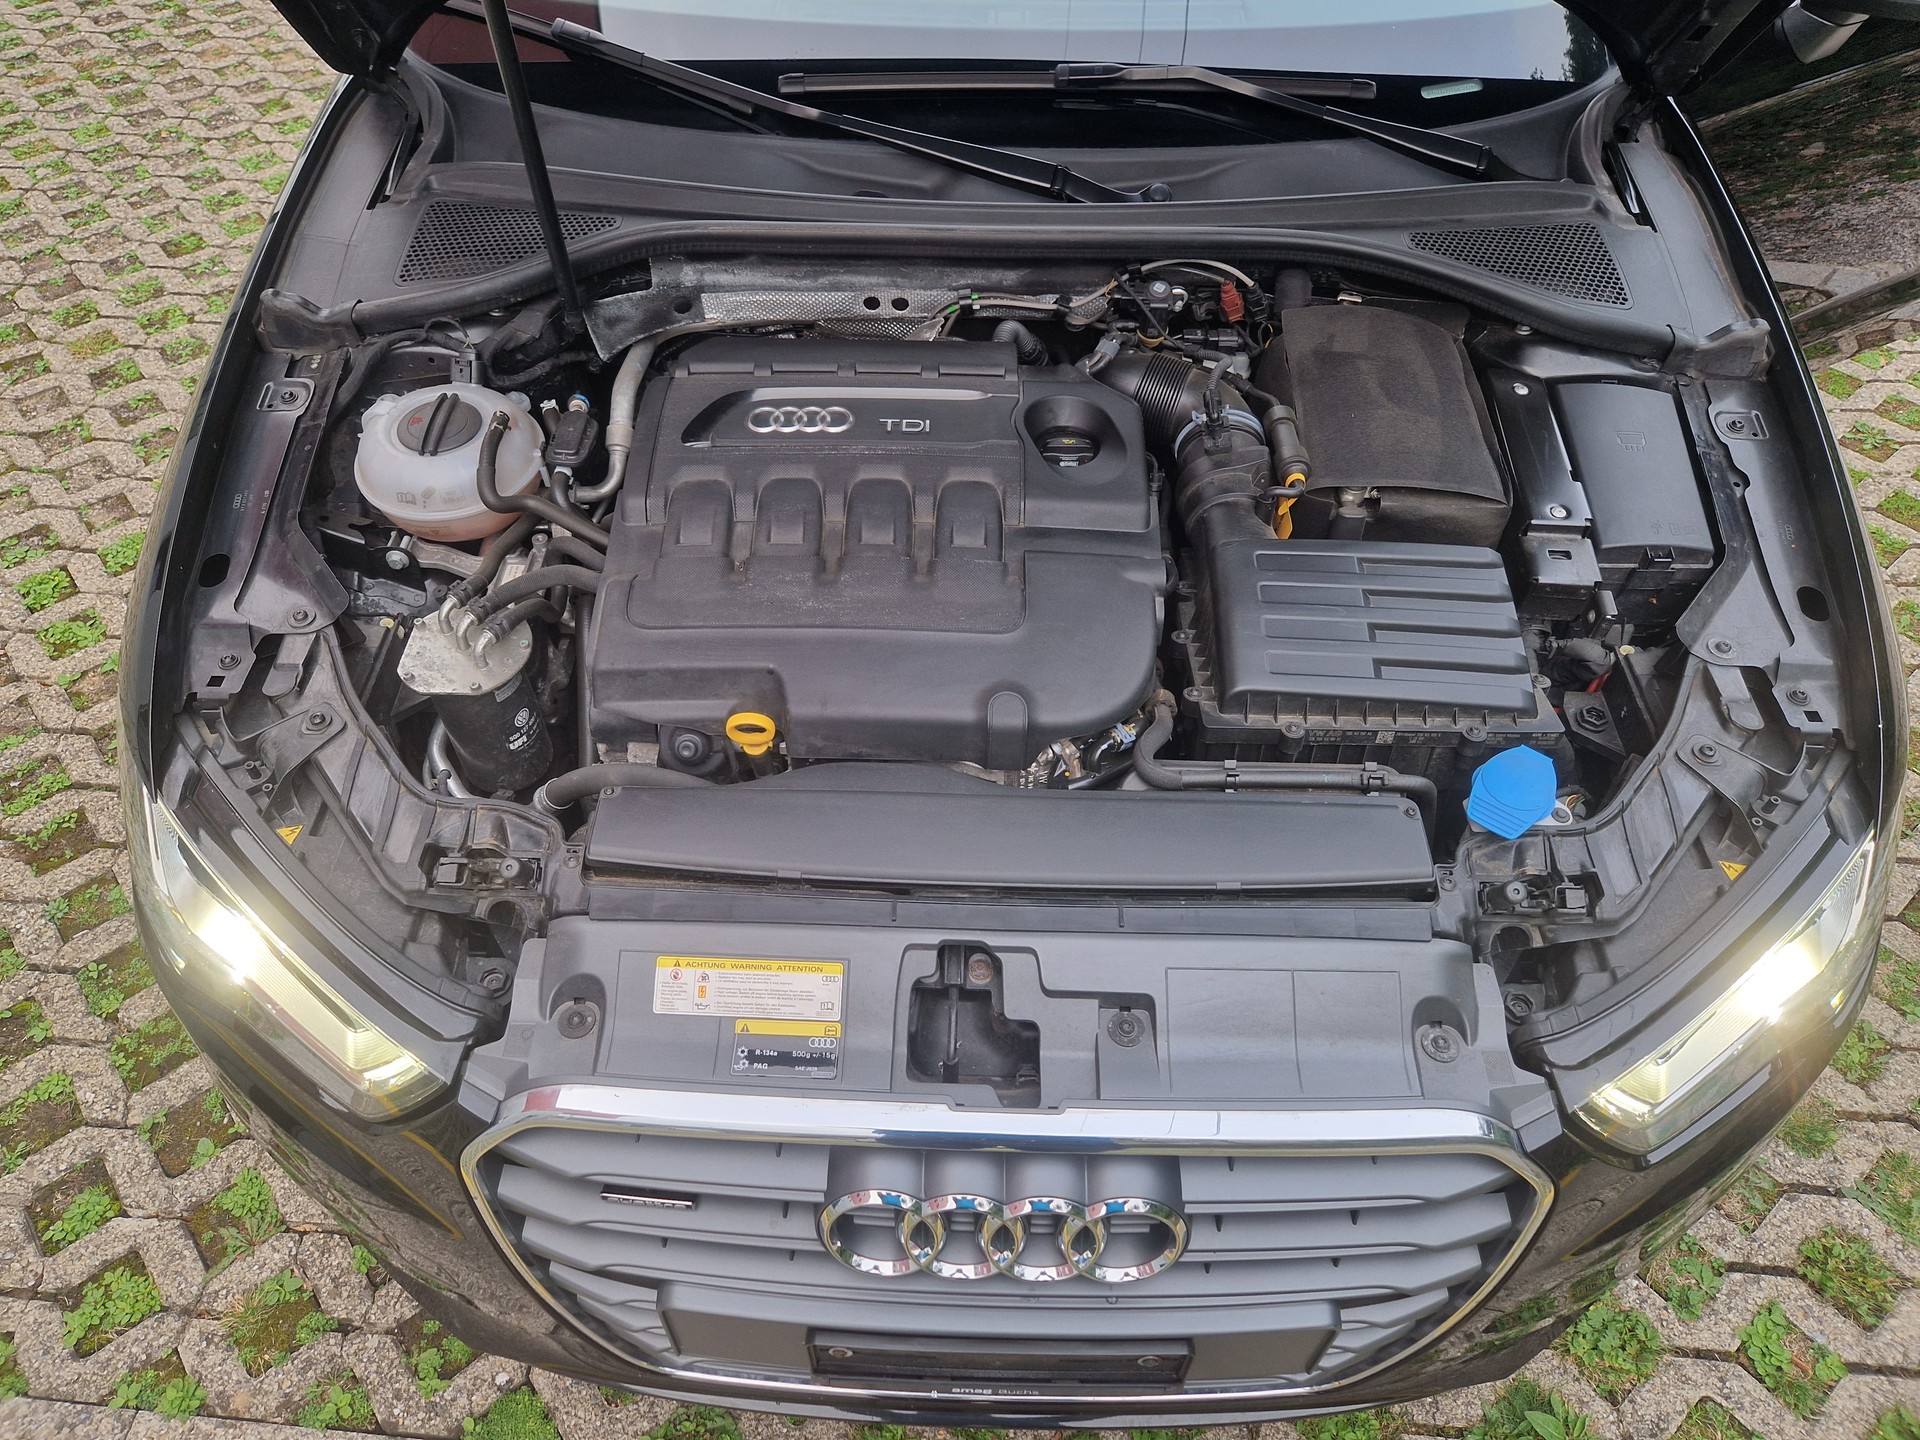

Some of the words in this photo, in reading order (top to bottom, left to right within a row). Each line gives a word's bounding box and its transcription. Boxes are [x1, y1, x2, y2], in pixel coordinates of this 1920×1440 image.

[879, 418, 930, 432] TDI
[685, 961, 726, 969] ACHTUNG
[731, 963, 772, 971] WARNING
[777, 964, 823, 973] ATTENTION
[792, 1050, 811, 1058] 500g
[753, 1062, 768, 1070] PAG
